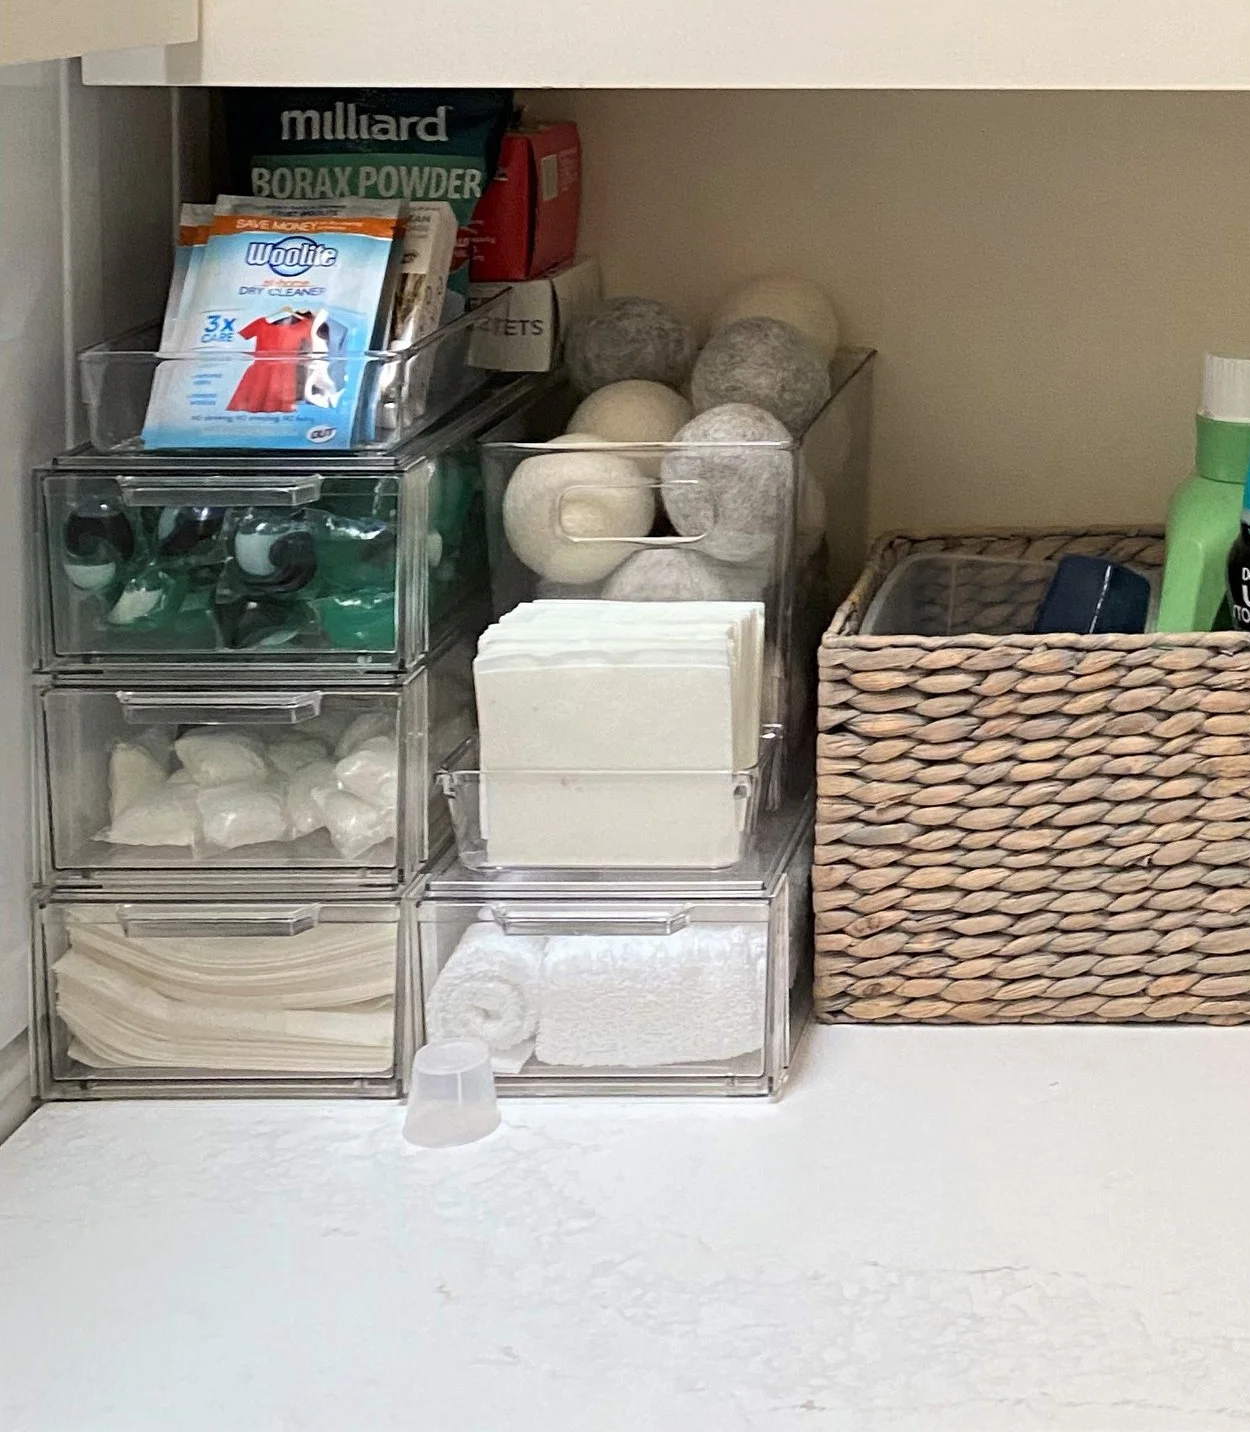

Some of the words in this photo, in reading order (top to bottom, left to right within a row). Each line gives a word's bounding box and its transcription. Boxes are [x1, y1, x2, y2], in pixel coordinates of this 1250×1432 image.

[280, 102, 450, 142] milliard
[252, 165, 353, 200] BORAX
[358, 166, 483, 200] POWDER
[236, 218, 270, 230] SAVE
[271, 220, 318, 232] MONEY
[245, 240, 339, 268] Woolite
[239, 286, 264, 296] DRY
[267, 286, 326, 297] CLEANER
[201, 332, 235, 343] CARE
